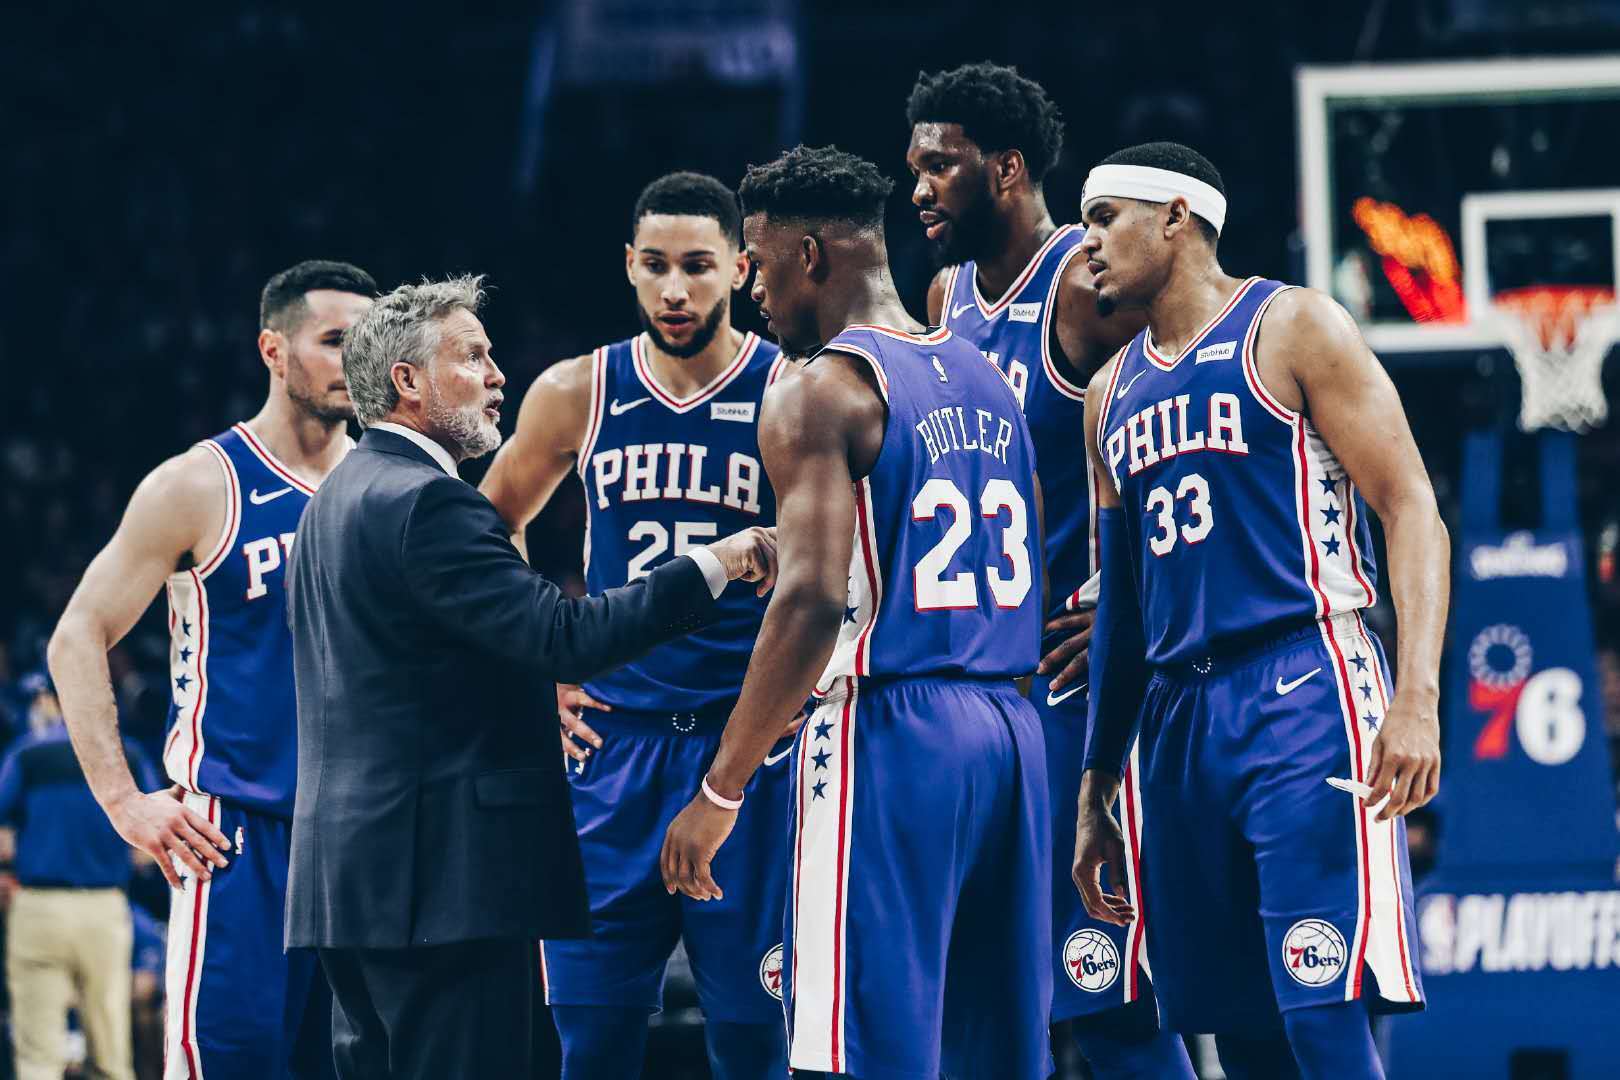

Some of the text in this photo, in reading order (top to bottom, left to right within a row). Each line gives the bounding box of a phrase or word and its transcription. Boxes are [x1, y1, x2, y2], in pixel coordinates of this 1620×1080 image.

[915, 406, 1013, 465] BUTLER
[1106, 392, 1249, 496] PHILA
[592, 443, 761, 515] PHILA
[1146, 473, 1214, 557] 33
[911, 478, 1032, 612] 23
[1469, 666, 1587, 766] 76
[1069, 954, 1116, 980] 76ers
[1290, 945, 1341, 969] 76ers
